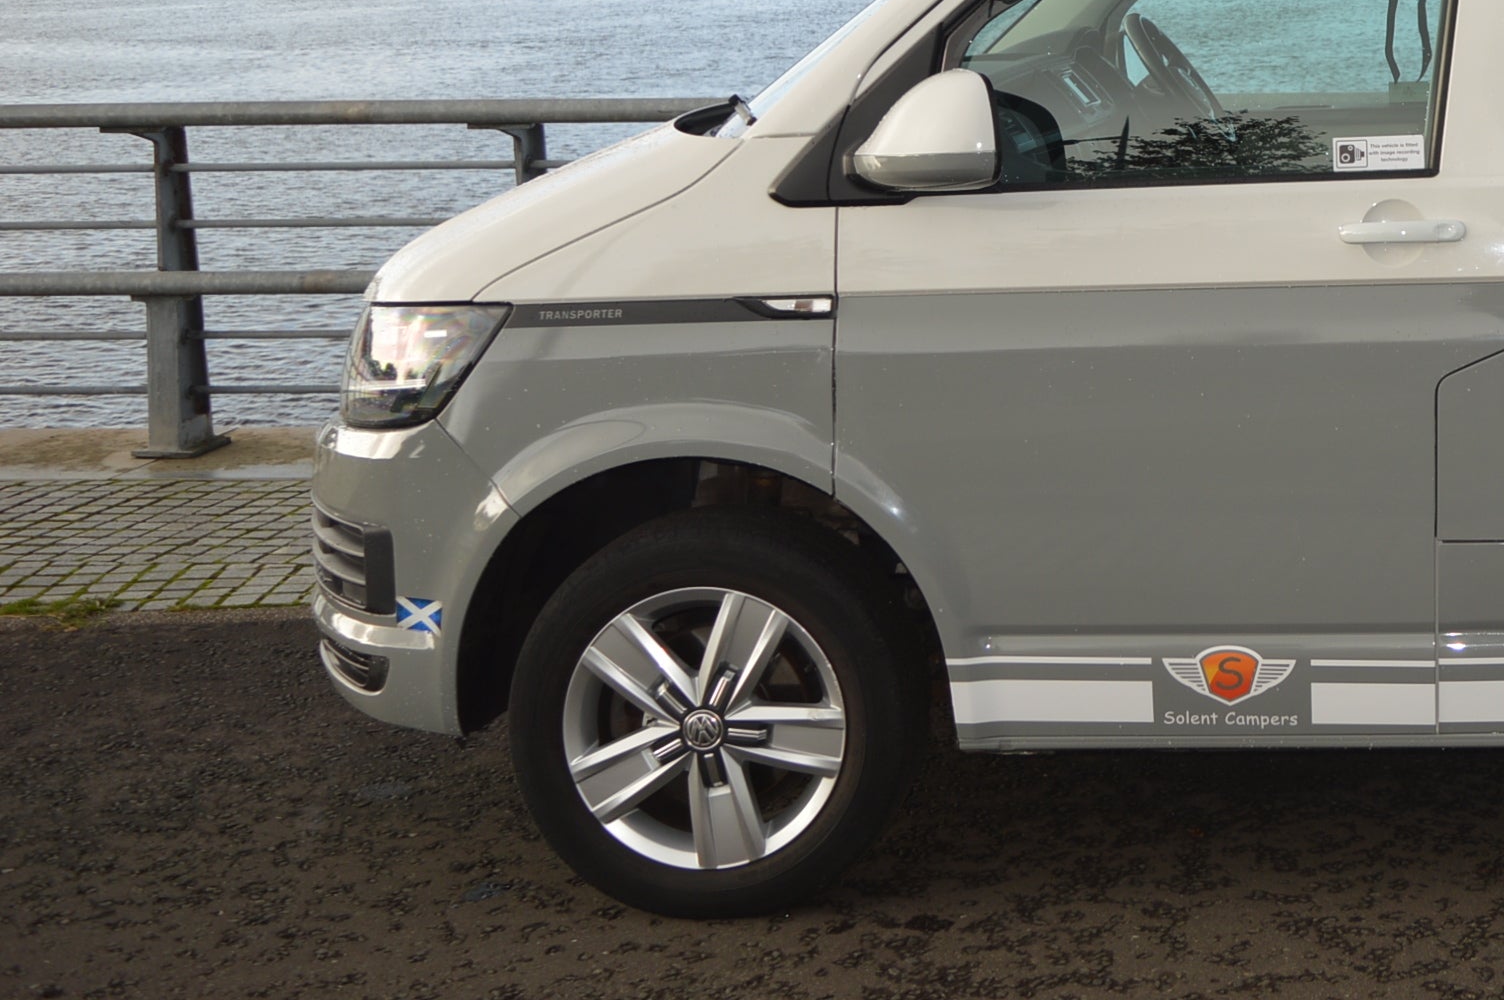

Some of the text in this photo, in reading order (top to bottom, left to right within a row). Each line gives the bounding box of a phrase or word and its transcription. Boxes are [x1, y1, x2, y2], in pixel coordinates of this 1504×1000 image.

[539, 308, 623, 321] TRANSPORTER
[1215, 656, 1245, 691] S
[1163, 709, 1299, 730] Solent Campers
